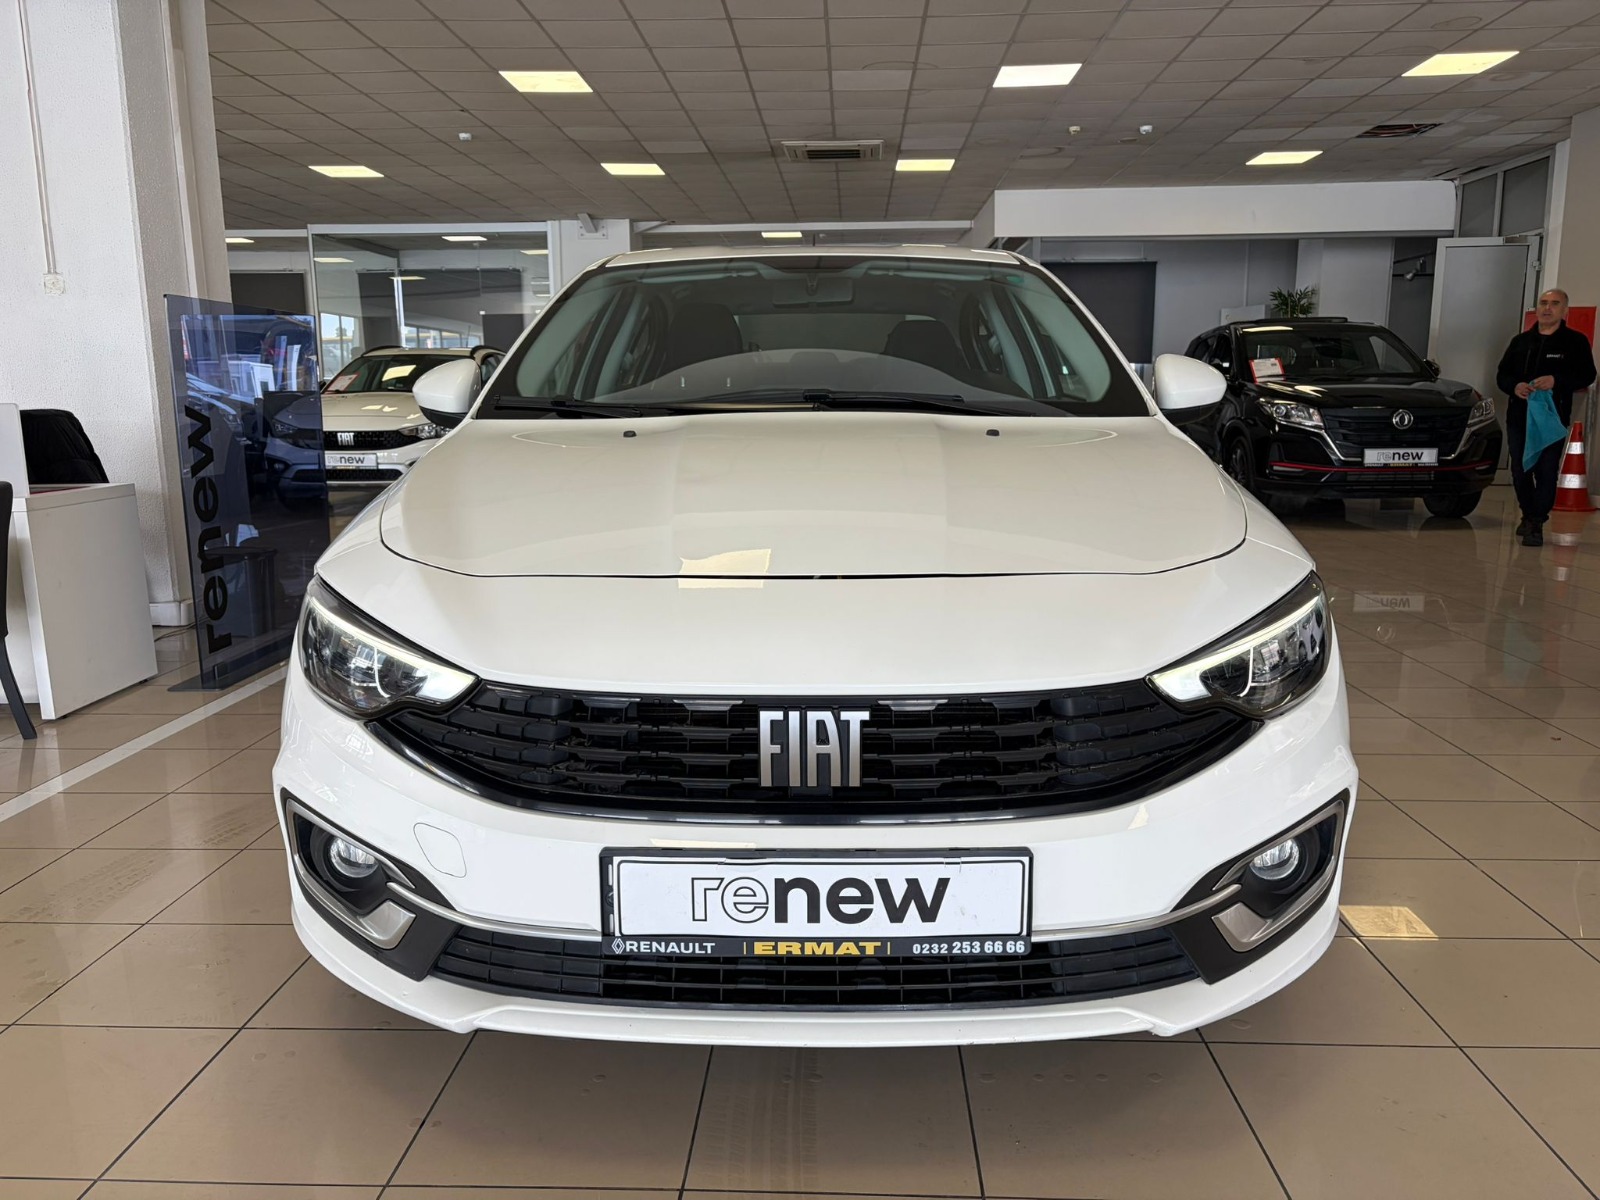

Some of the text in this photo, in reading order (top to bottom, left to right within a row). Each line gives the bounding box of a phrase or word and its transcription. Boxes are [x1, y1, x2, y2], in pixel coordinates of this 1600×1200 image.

[337, 432, 355, 446] FIAT
[1376, 451, 1424, 461] renew
[184, 404, 232, 654] renew
[759, 710, 870, 787] FIAT
[691, 876, 951, 924] renew
[625, 940, 1025, 955] RENAULT ERMAT 0232 253 66 66
